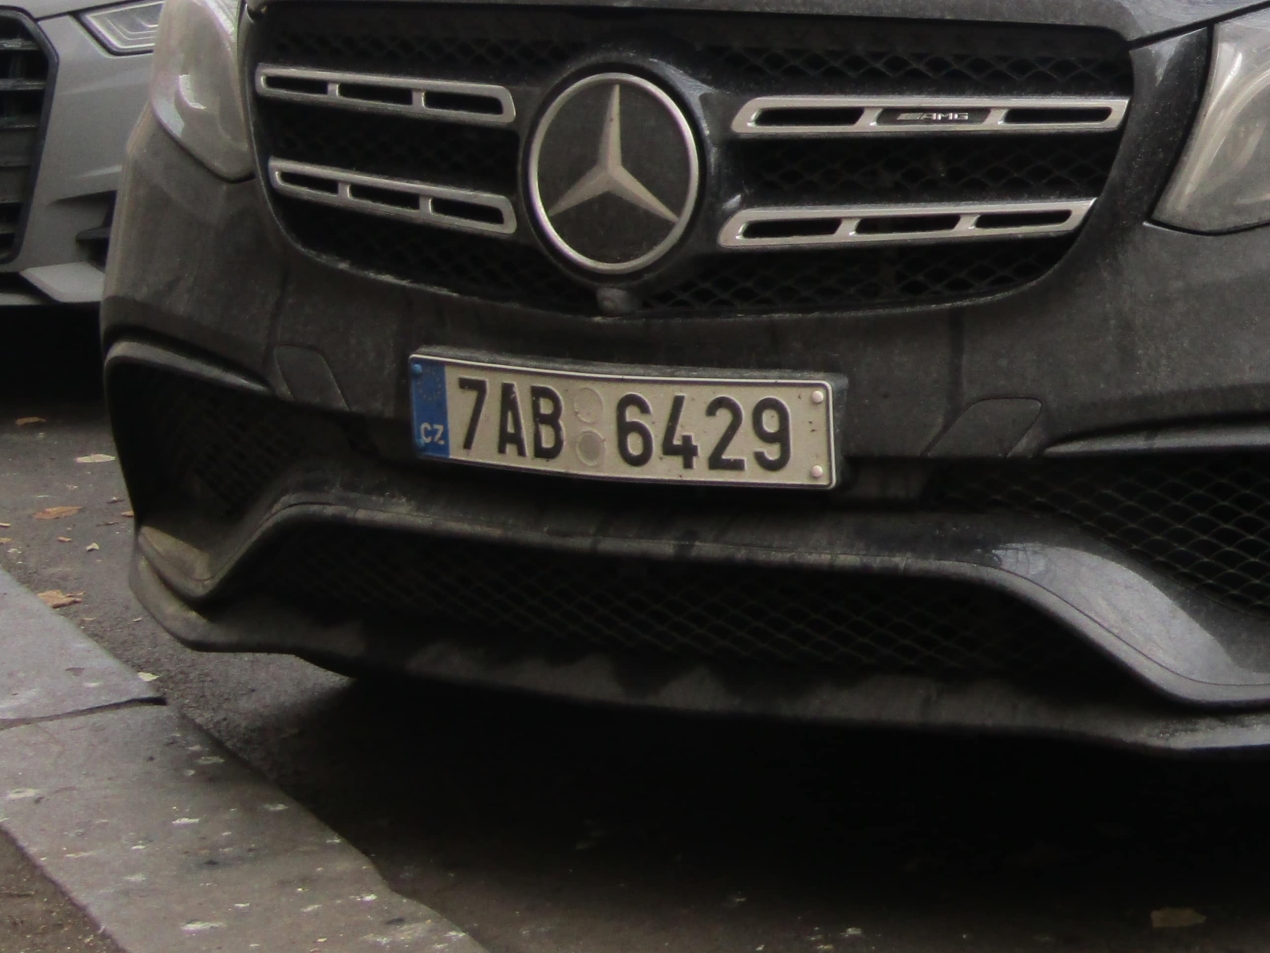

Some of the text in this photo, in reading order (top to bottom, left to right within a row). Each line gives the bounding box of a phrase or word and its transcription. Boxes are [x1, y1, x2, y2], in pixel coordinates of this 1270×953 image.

[921, 112, 969, 120] AMG
[419, 422, 445, 446] CZ
[457, 376, 793, 473] 7AB 6429
